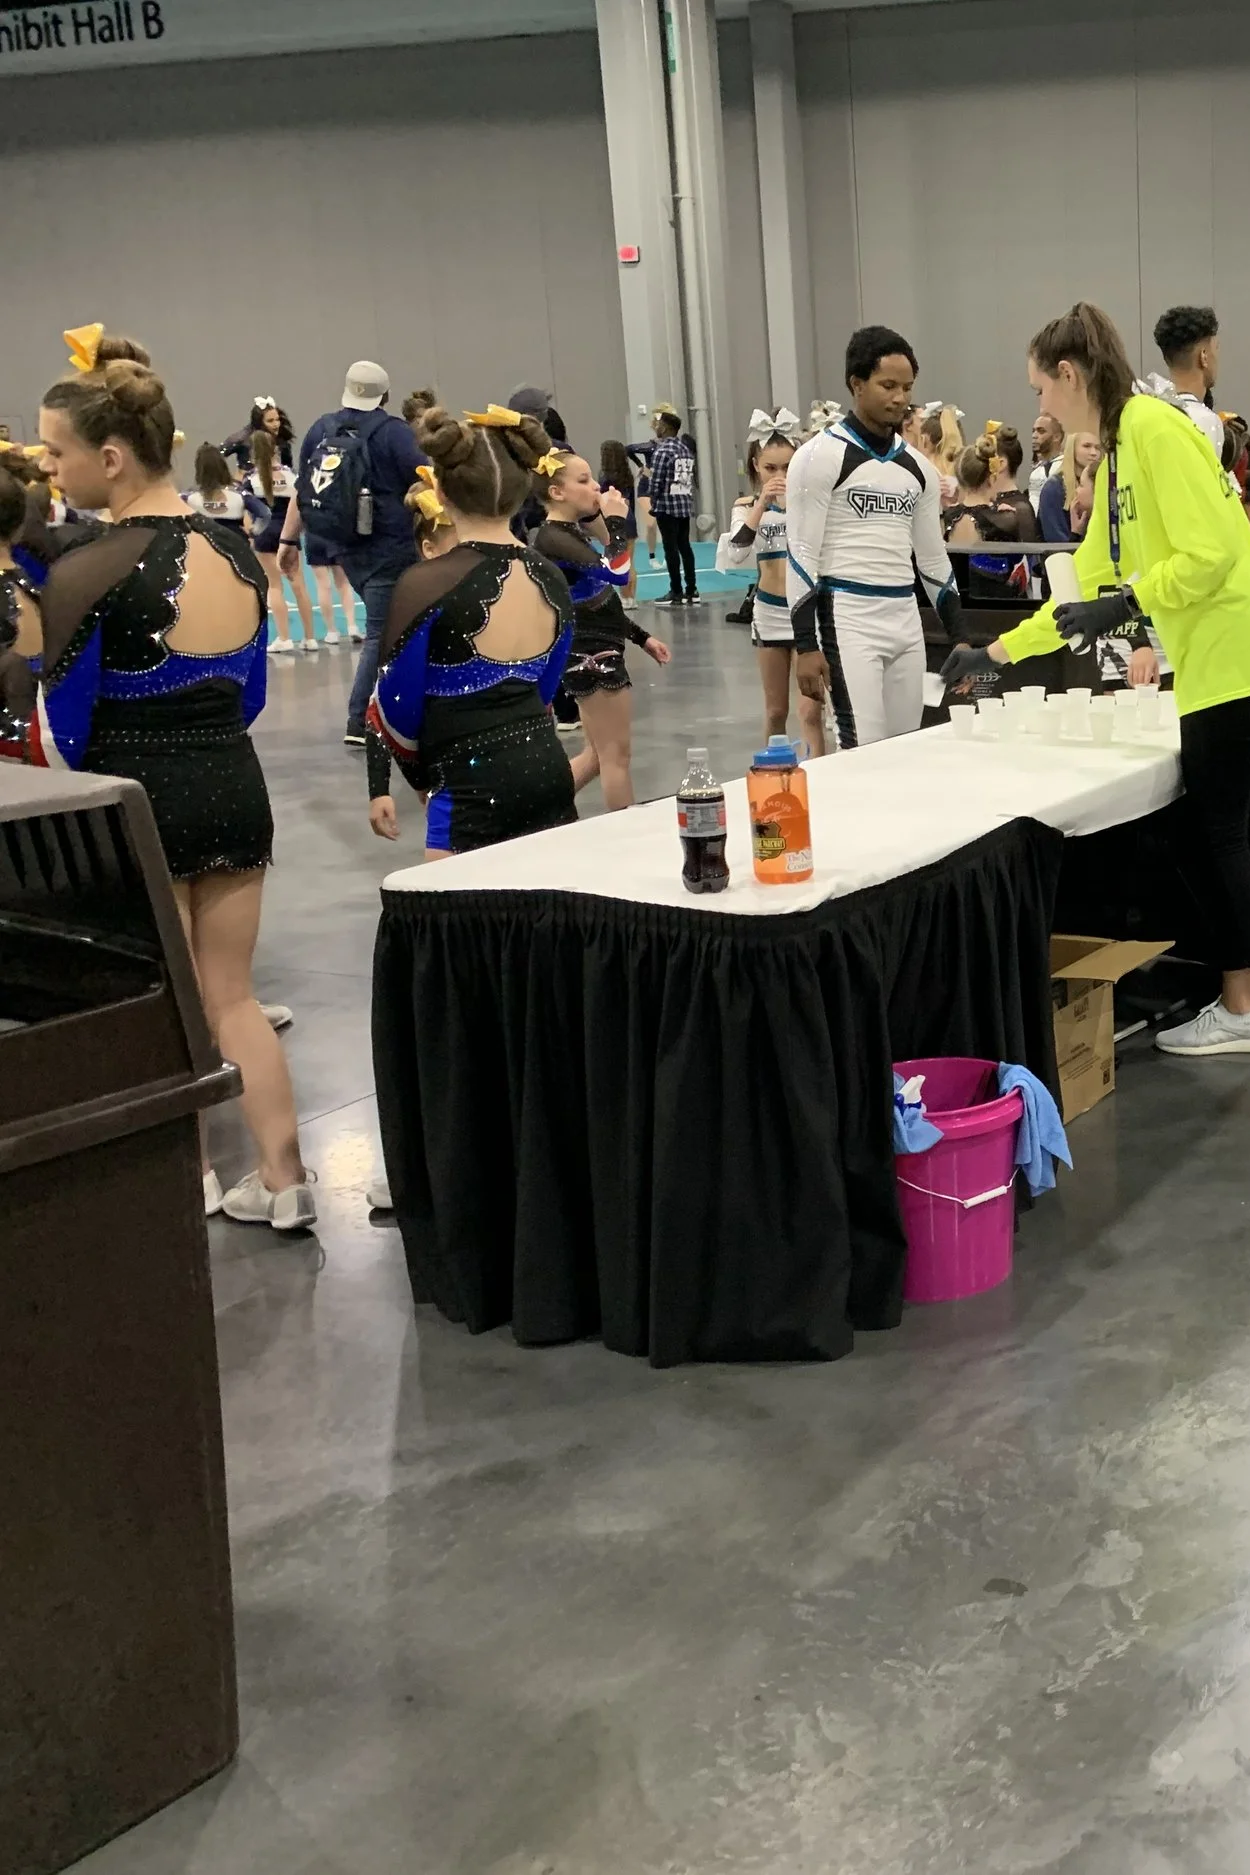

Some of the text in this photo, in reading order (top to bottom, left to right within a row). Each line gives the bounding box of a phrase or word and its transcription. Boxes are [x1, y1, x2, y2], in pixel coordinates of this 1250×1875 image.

[71, 1, 134, 46] Hall
[141, 0, 165, 39] B
[847, 488, 920, 519] GALAXY
